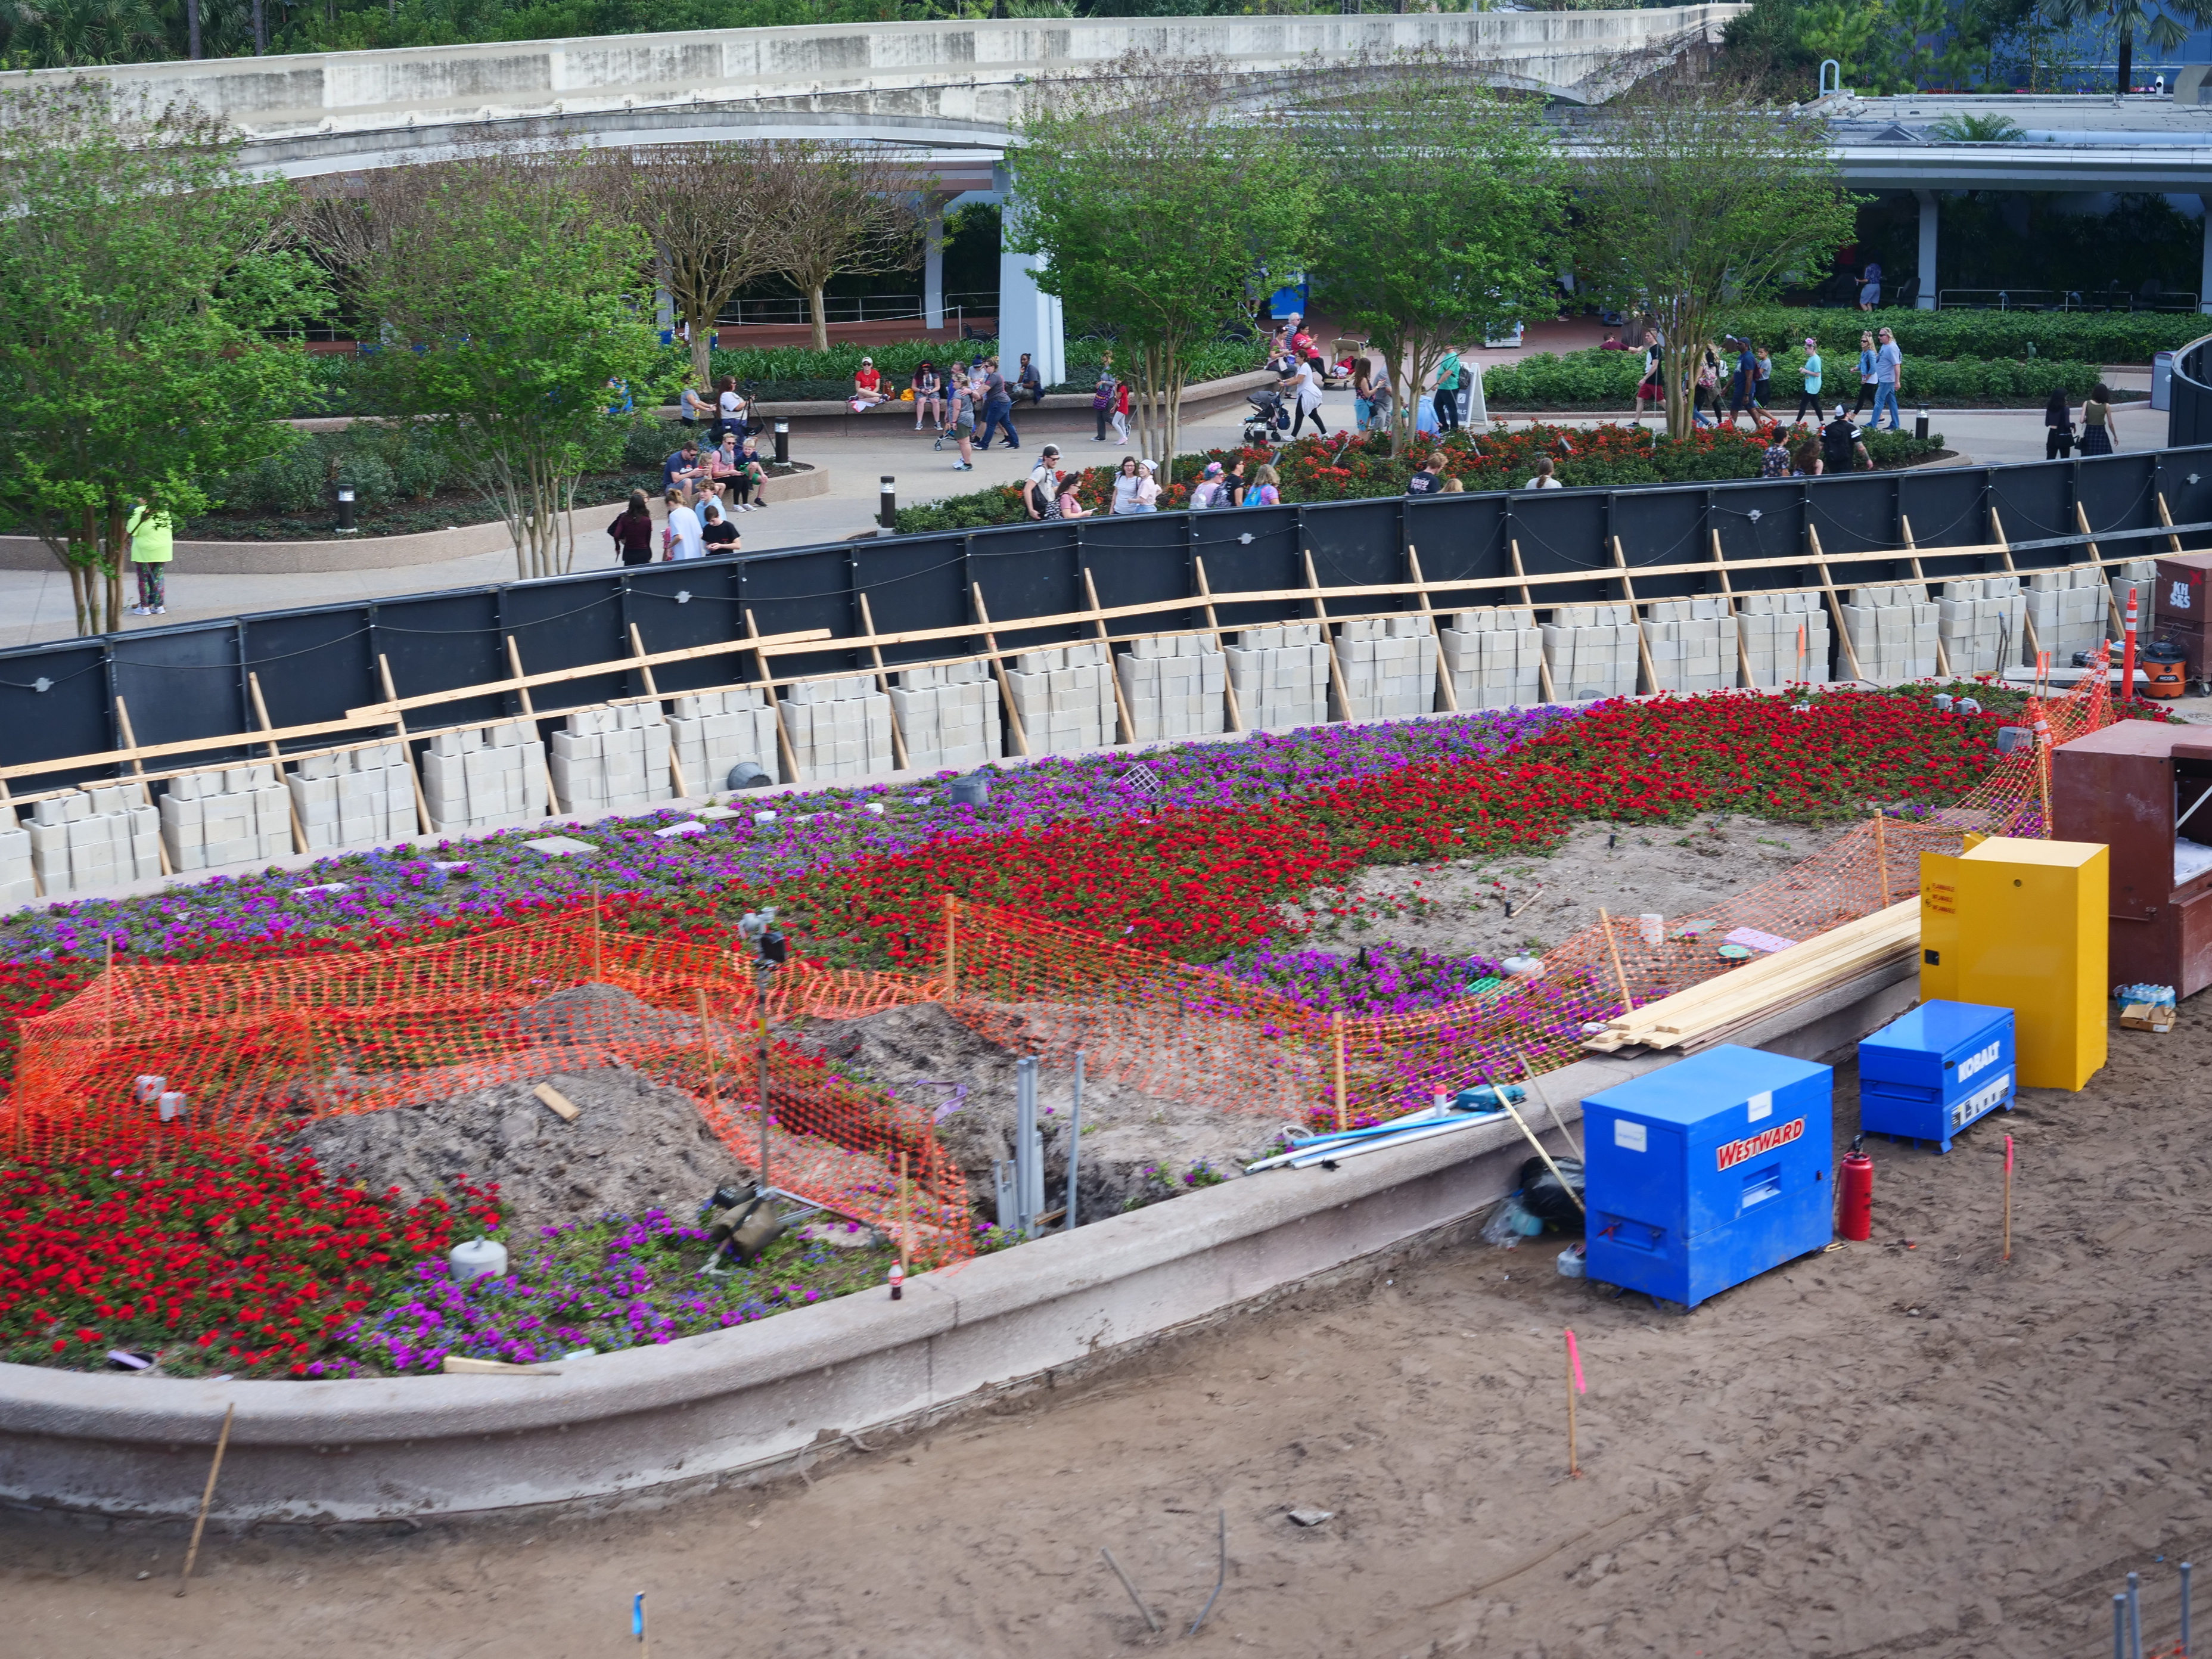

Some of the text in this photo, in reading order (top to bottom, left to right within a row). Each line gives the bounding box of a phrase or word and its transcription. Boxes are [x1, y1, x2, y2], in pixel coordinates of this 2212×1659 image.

[2170, 592, 2191, 608] S&S
[2173, 580, 2189, 596] KH
[1958, 1040, 2000, 1083] KOBALT
[1717, 1119, 1804, 1172] WESTWARD
